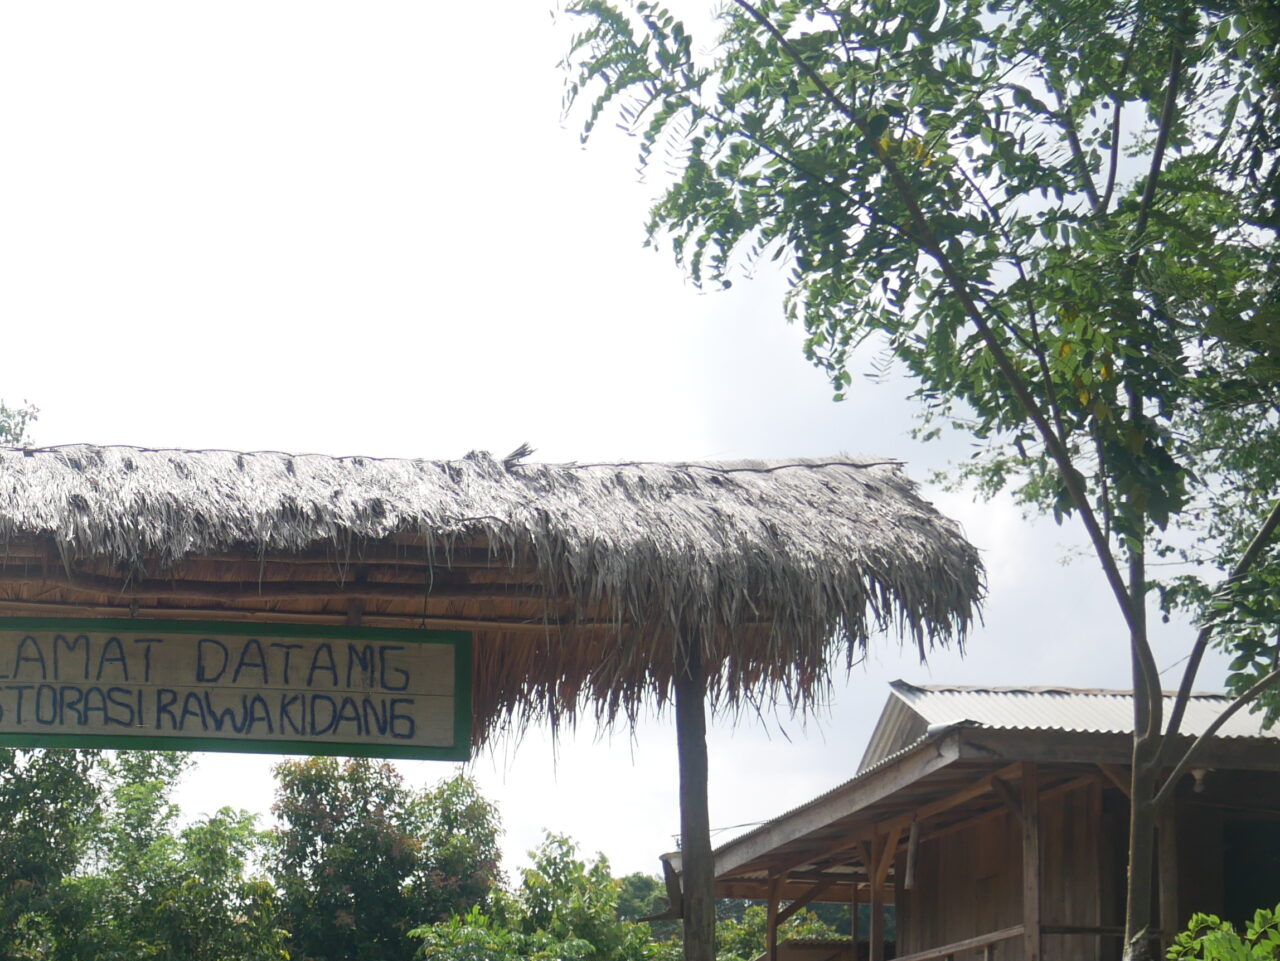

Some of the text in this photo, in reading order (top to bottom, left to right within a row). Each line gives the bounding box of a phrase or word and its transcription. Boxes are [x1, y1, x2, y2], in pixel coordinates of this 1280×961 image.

[195, 638, 410, 691] DATANG
[155, 688, 274, 735] RAWA
[279, 693, 416, 739] KIDANG
